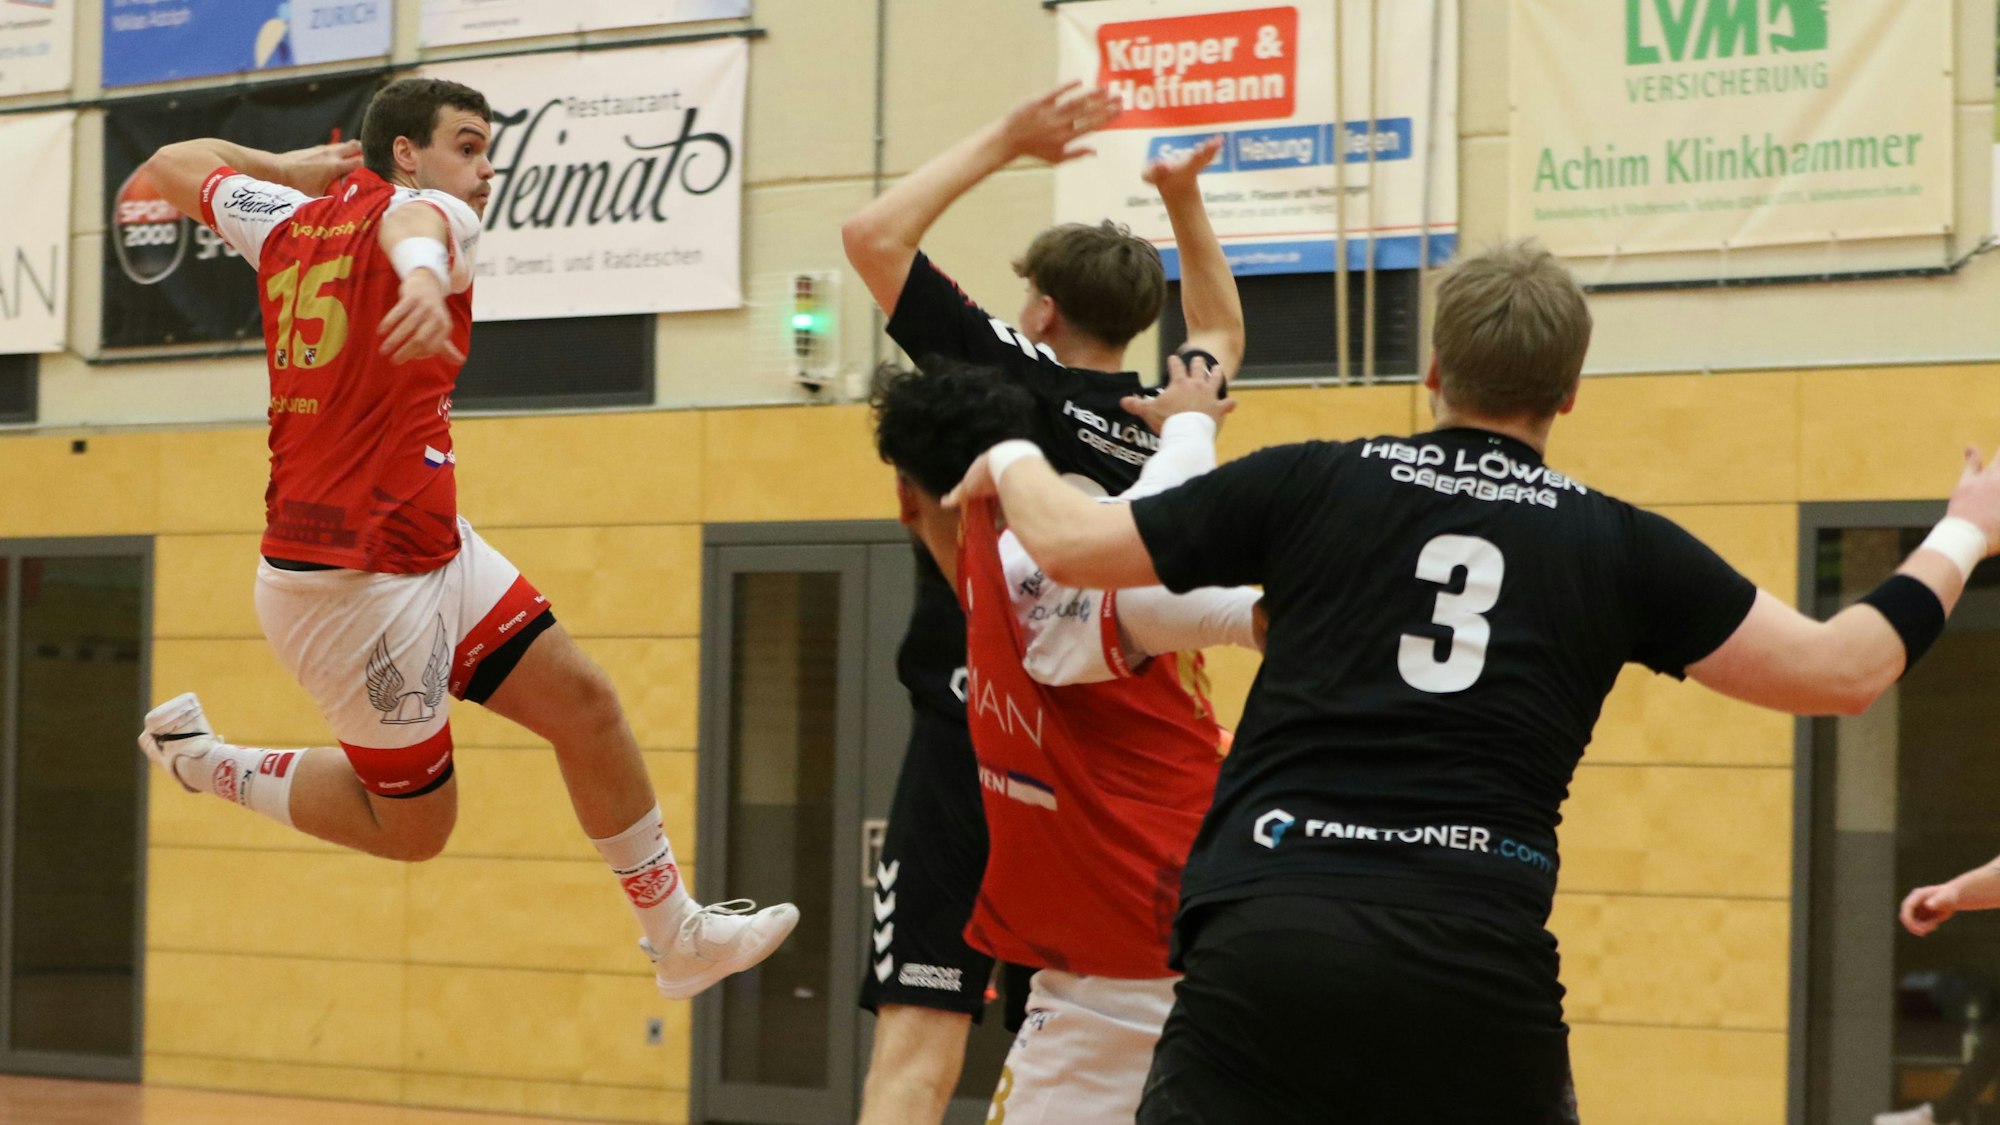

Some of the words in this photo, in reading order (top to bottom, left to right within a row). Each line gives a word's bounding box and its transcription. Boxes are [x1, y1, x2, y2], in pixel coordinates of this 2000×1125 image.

[1106, 35, 1240, 76] Küpper
[1253, 25, 1284, 59] &
[1625, 0, 1760, 66] LVM
[1108, 73, 1285, 112] Hoffmann
[1625, 62, 1828, 103] VERSICHERUNG
[484, 98, 733, 232] Heimat
[1533, 144, 1650, 192] Achim
[1666, 132, 1924, 184] Klinkhammer
[124, 224, 178, 247] 2000
[266, 254, 354, 370] 15
[1390, 465, 1558, 510] OBERBERG
[1454, 448, 1588, 496] LÖWEN
[498, 609, 527, 633] Kempa
[1397, 533, 1506, 694] 3
